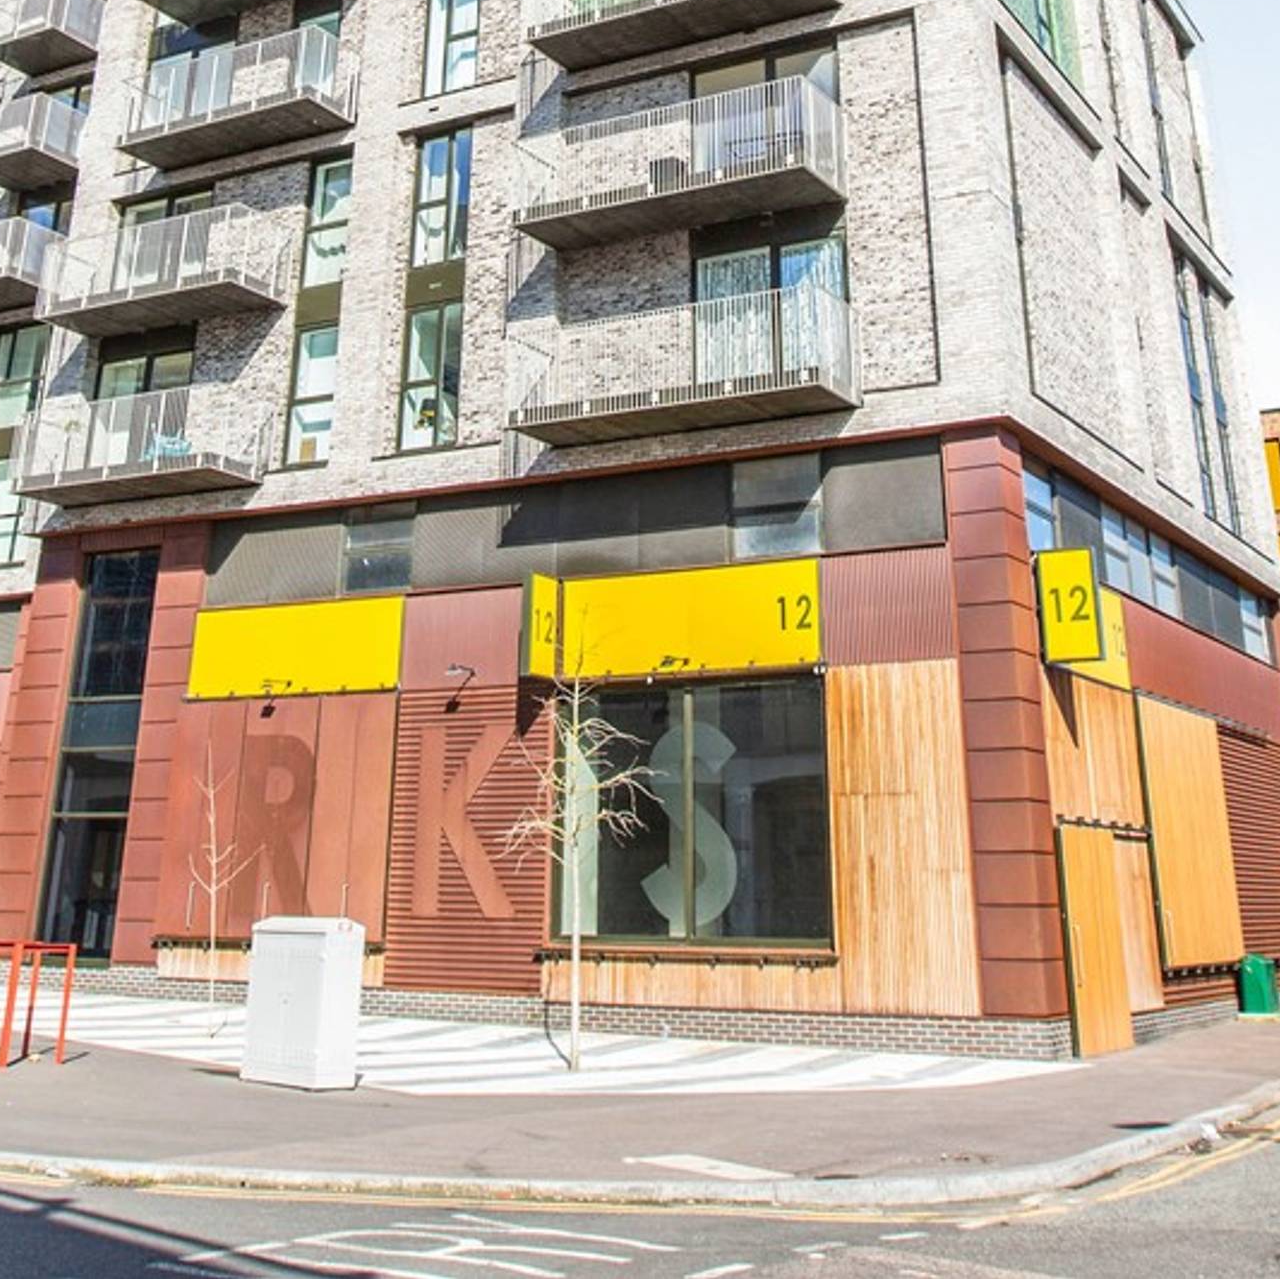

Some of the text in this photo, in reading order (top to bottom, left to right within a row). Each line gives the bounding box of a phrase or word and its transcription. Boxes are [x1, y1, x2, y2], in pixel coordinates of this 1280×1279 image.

[776, 594, 813, 631] 12
[1049, 584, 1091, 624] 12
[534, 608, 554, 644] 12
